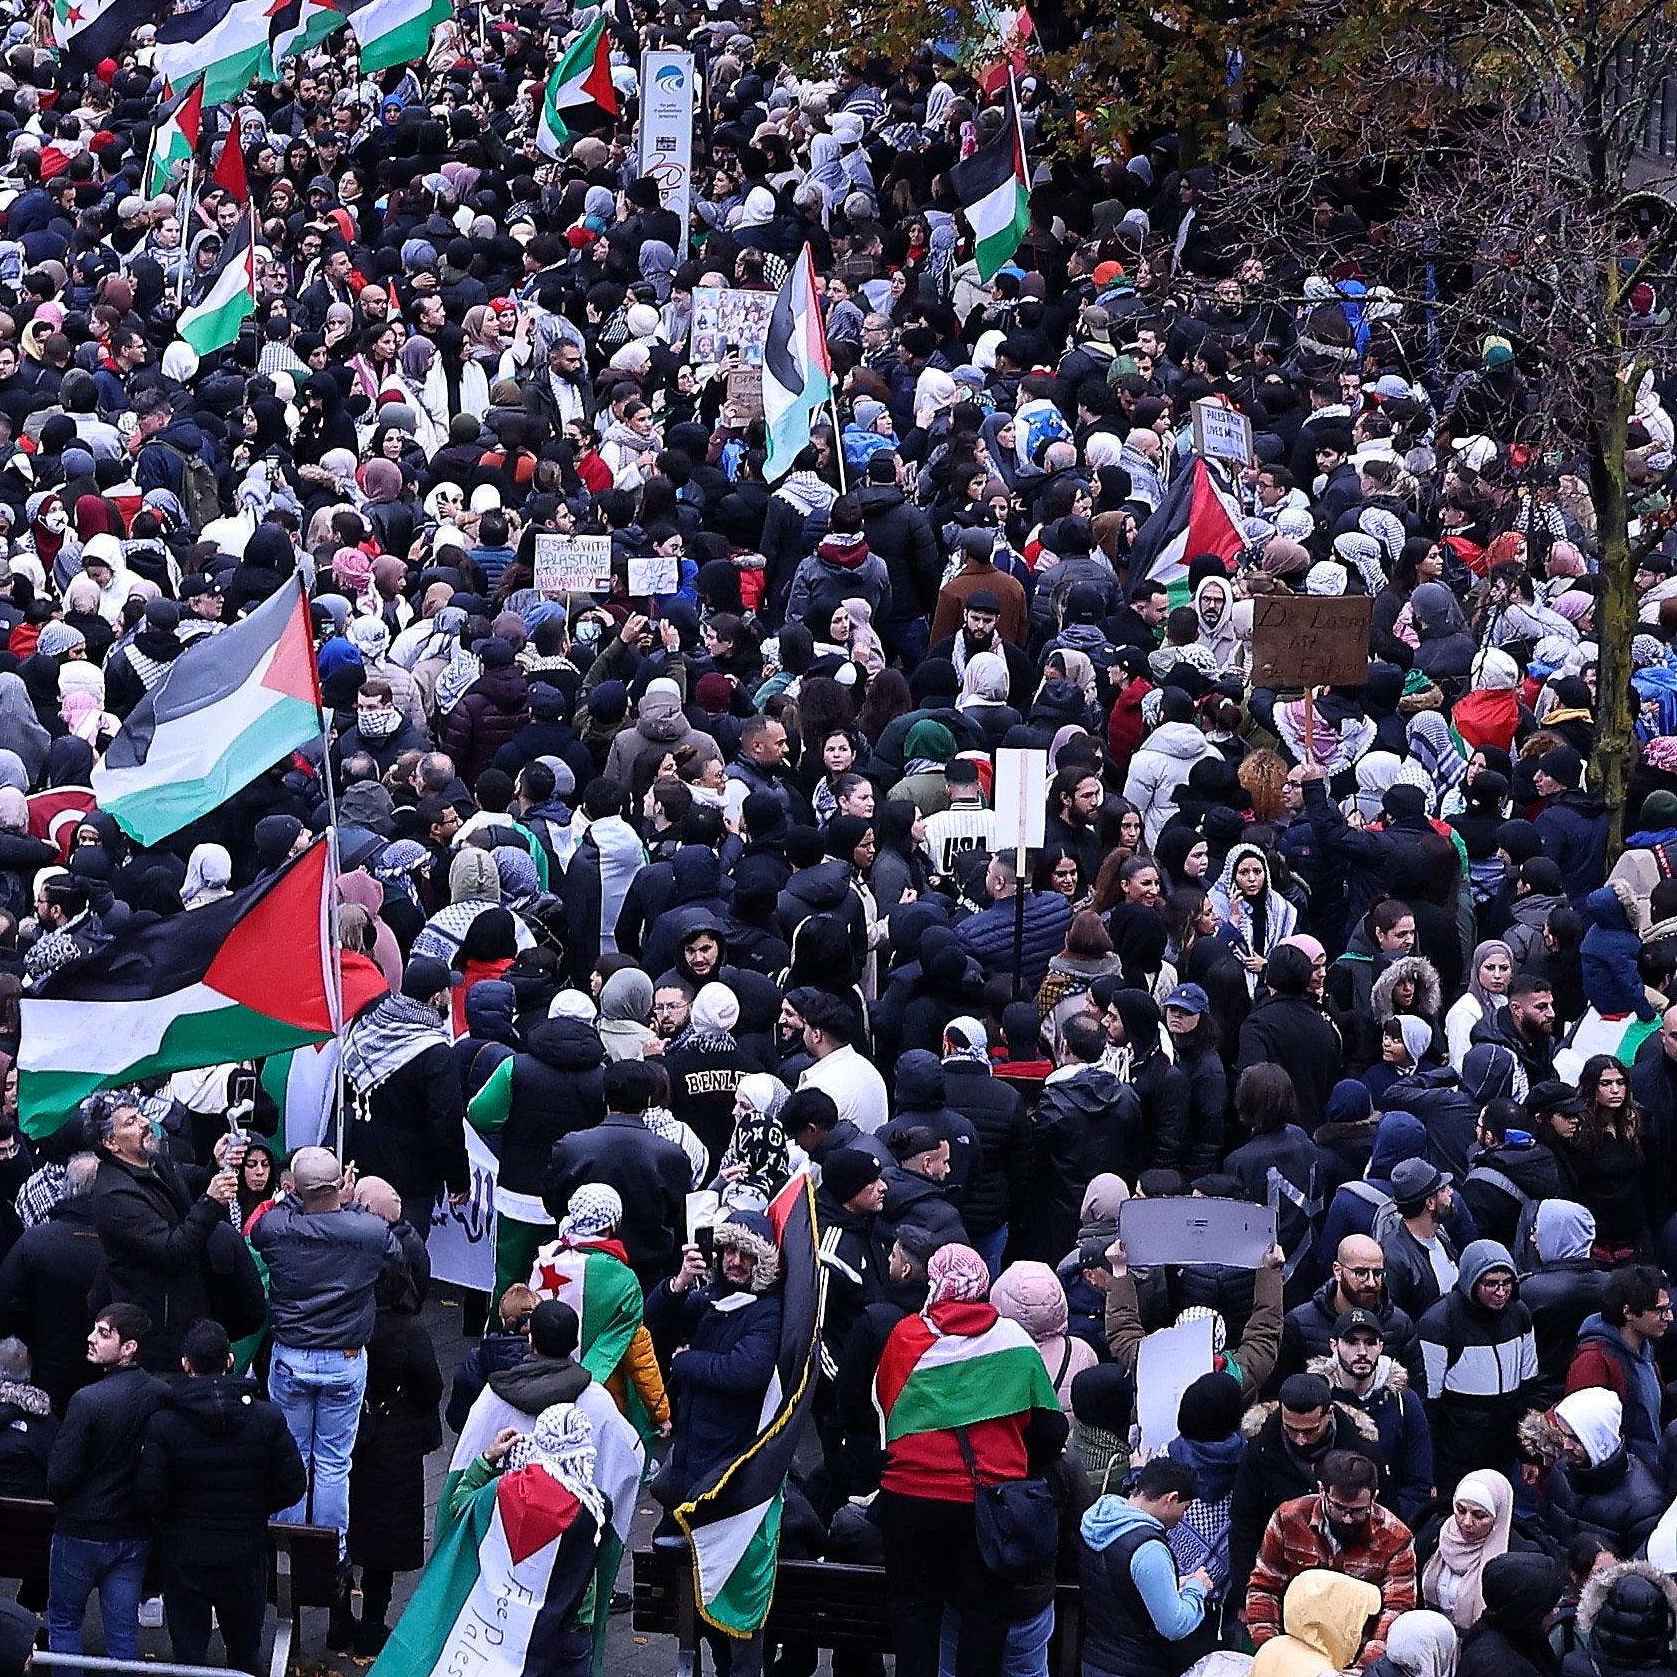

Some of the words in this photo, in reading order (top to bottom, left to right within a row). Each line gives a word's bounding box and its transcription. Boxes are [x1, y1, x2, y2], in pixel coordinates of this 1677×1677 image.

[581, 539, 610, 553] WITH
[539, 574, 594, 588] HUMANITY
[685, 1069, 746, 1095] BENL
[496, 1570, 534, 1620] Free
[447, 1606, 504, 1677] Pales
